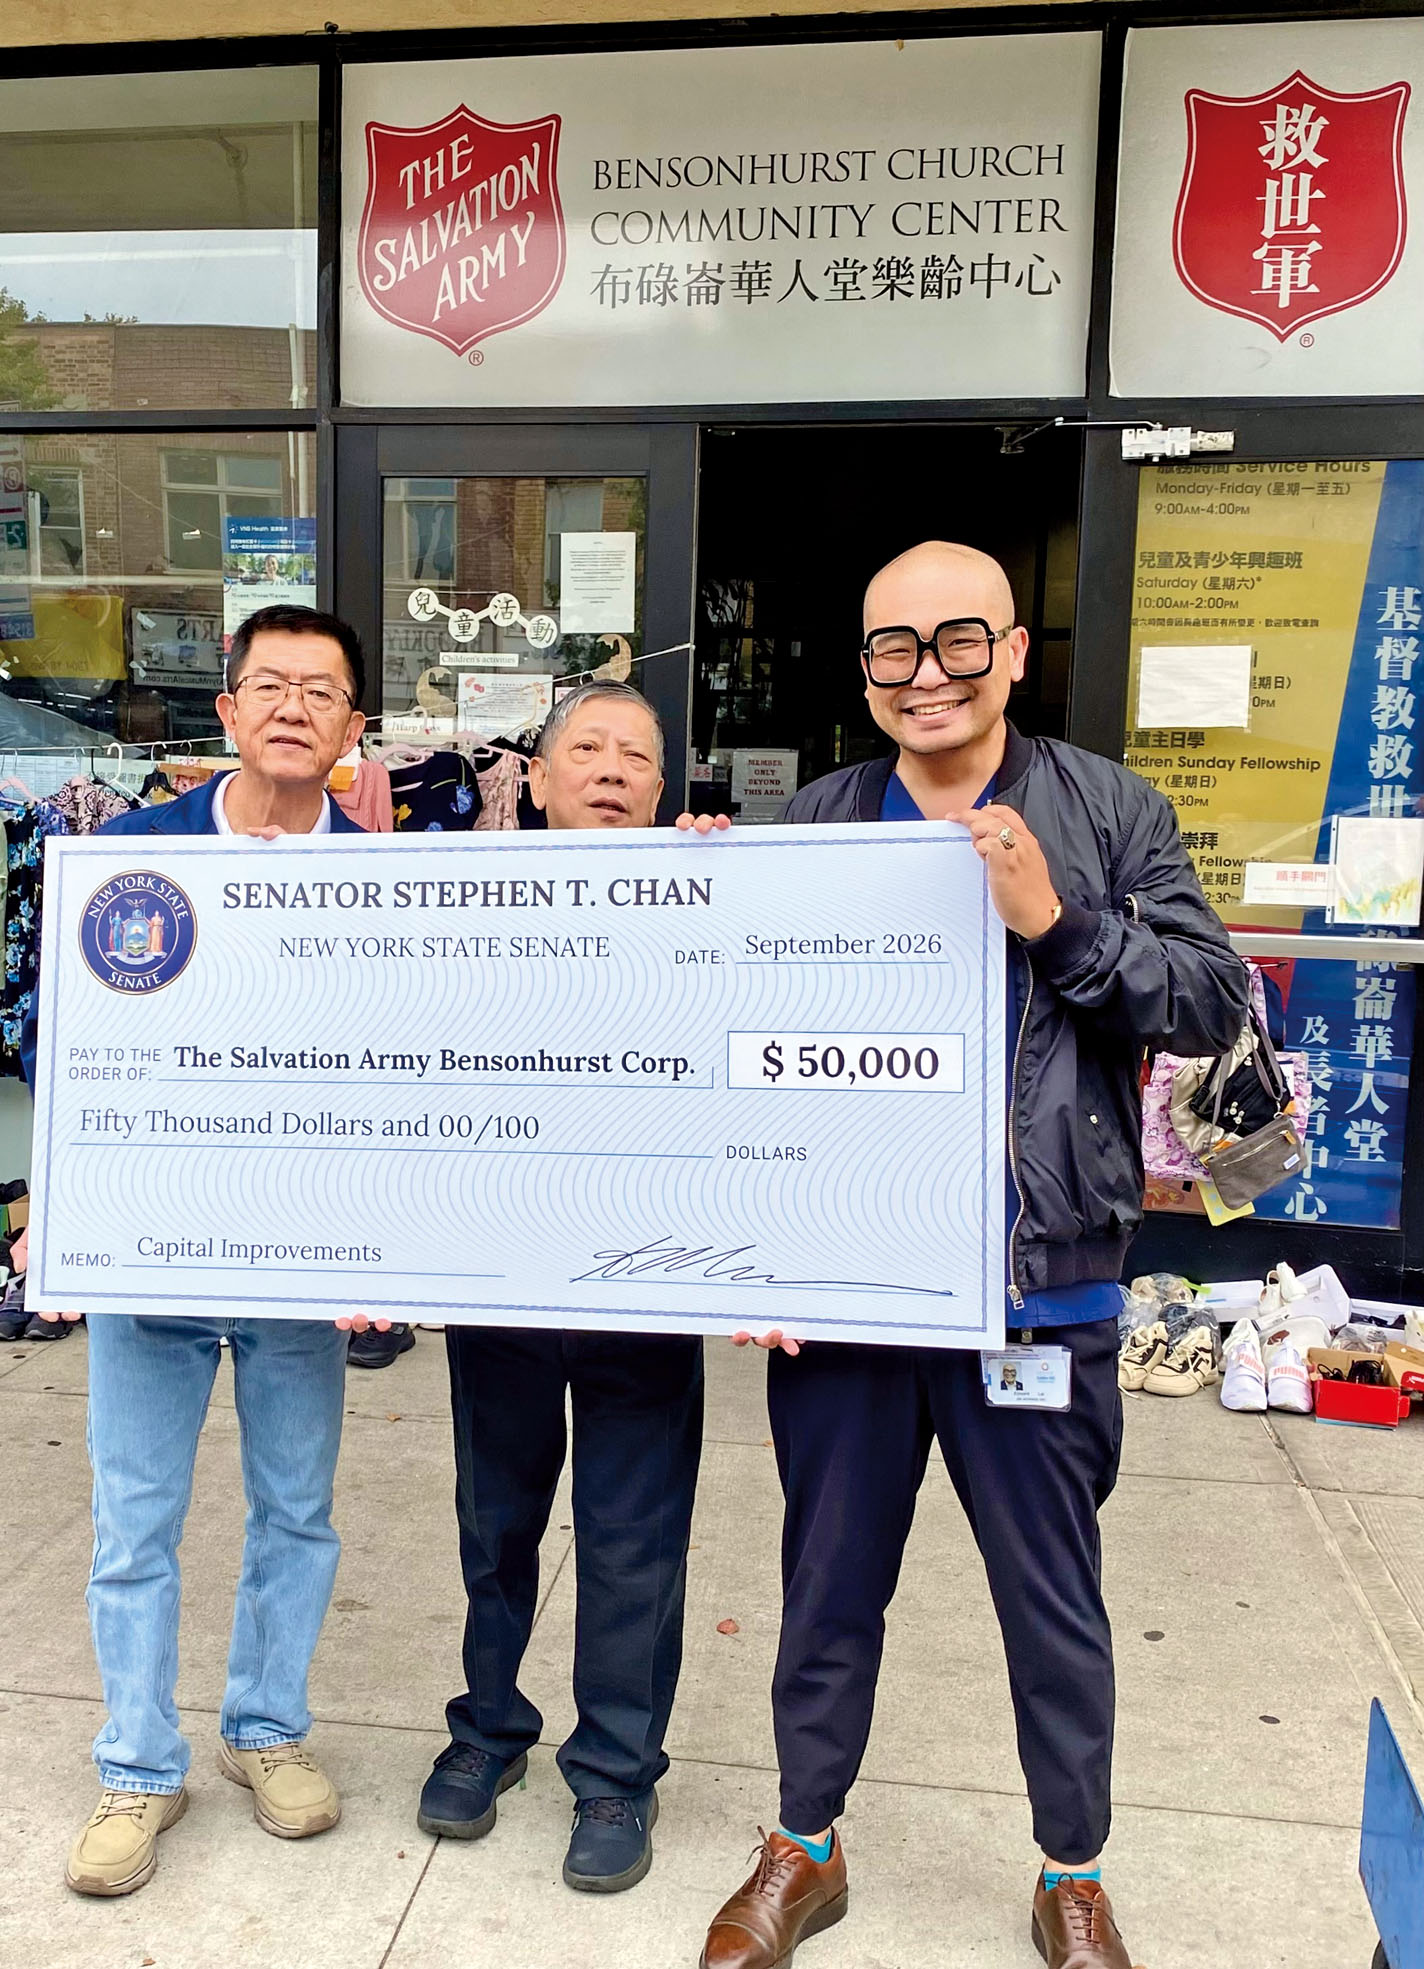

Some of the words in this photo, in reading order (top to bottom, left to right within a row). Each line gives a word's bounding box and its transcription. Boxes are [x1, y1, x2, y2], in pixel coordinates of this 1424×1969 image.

[399, 133, 474, 210] THE
[593, 150, 876, 190] BENSONHURST
[887, 144, 1065, 180] CHURCH
[373, 142, 540, 291] SALVATION
[1250, 103, 1330, 308] 救世軍
[590, 203, 876, 246] COMMUNITY
[890, 198, 1069, 237] CENTER
[432, 211, 535, 323] ARMY
[590, 252, 1062, 309] 布碌崙華人堂樂齡中心
[1156, 481, 1262, 496] Monday-Friday
[1267, 481, 1351, 496] (星期一至五)
[1154, 502, 1250, 515] 9:00AM-4:00PM
[1138, 551, 1302, 569] 兒童及青少年興趣班
[1136, 576, 1198, 590] Saturday
[414, 591, 554, 644] 兒童活動
[1137, 597, 1239, 609] 10:00AM-2:00PM
[442, 655, 481, 664] Children's
[1178, 755, 1235, 772] Sunday
[1240, 757, 1321, 772] Fellowship
[764, 788, 785, 796] AREA
[1165, 775, 1217, 789] (星期日)
[88, 885, 114, 919] NEW
[115, 875, 156, 892] YORK
[157, 883, 189, 920] STATE
[222, 881, 383, 910] SENATOR
[392, 880, 555, 909] STEPHEN
[566, 879, 596, 907] T.
[607, 877, 713, 907] CHAN
[279, 937, 338, 958] NEW
[346, 937, 415, 958] YORK
[421, 937, 502, 958] STATE
[509, 936, 610, 958] SENATE
[674, 949, 726, 965] DATE:
[745, 933, 875, 961] September
[882, 934, 943, 955] 2026
[108, 971, 162, 989] SENATE
[69, 1048, 97, 1062] PAY
[102, 1048, 125, 1062] TO
[130, 1048, 161, 1062] THE
[173, 1046, 222, 1068] The
[230, 1046, 350, 1070] Salvation
[358, 1047, 430, 1078] Army
[439, 1048, 613, 1074] Bensonhurst
[622, 1050, 696, 1082] Corp.
[761, 1040, 784, 1082] $
[797, 1045, 939, 1085] 50,000
[68, 1066, 121, 1081] ORDER
[126, 1066, 152, 1081] OF:
[80, 1109, 138, 1139] Fifty
[144, 1110, 272, 1135] Thousand
[281, 1112, 373, 1137] Dollars
[381, 1113, 429, 1137] and
[439, 1114, 540, 1146] 00/100
[726, 1145, 807, 1162] DOLLARS
[60, 1252, 116, 1268] MEMO:
[137, 1236, 213, 1264] Capital
[221, 1239, 382, 1265] Improvements
